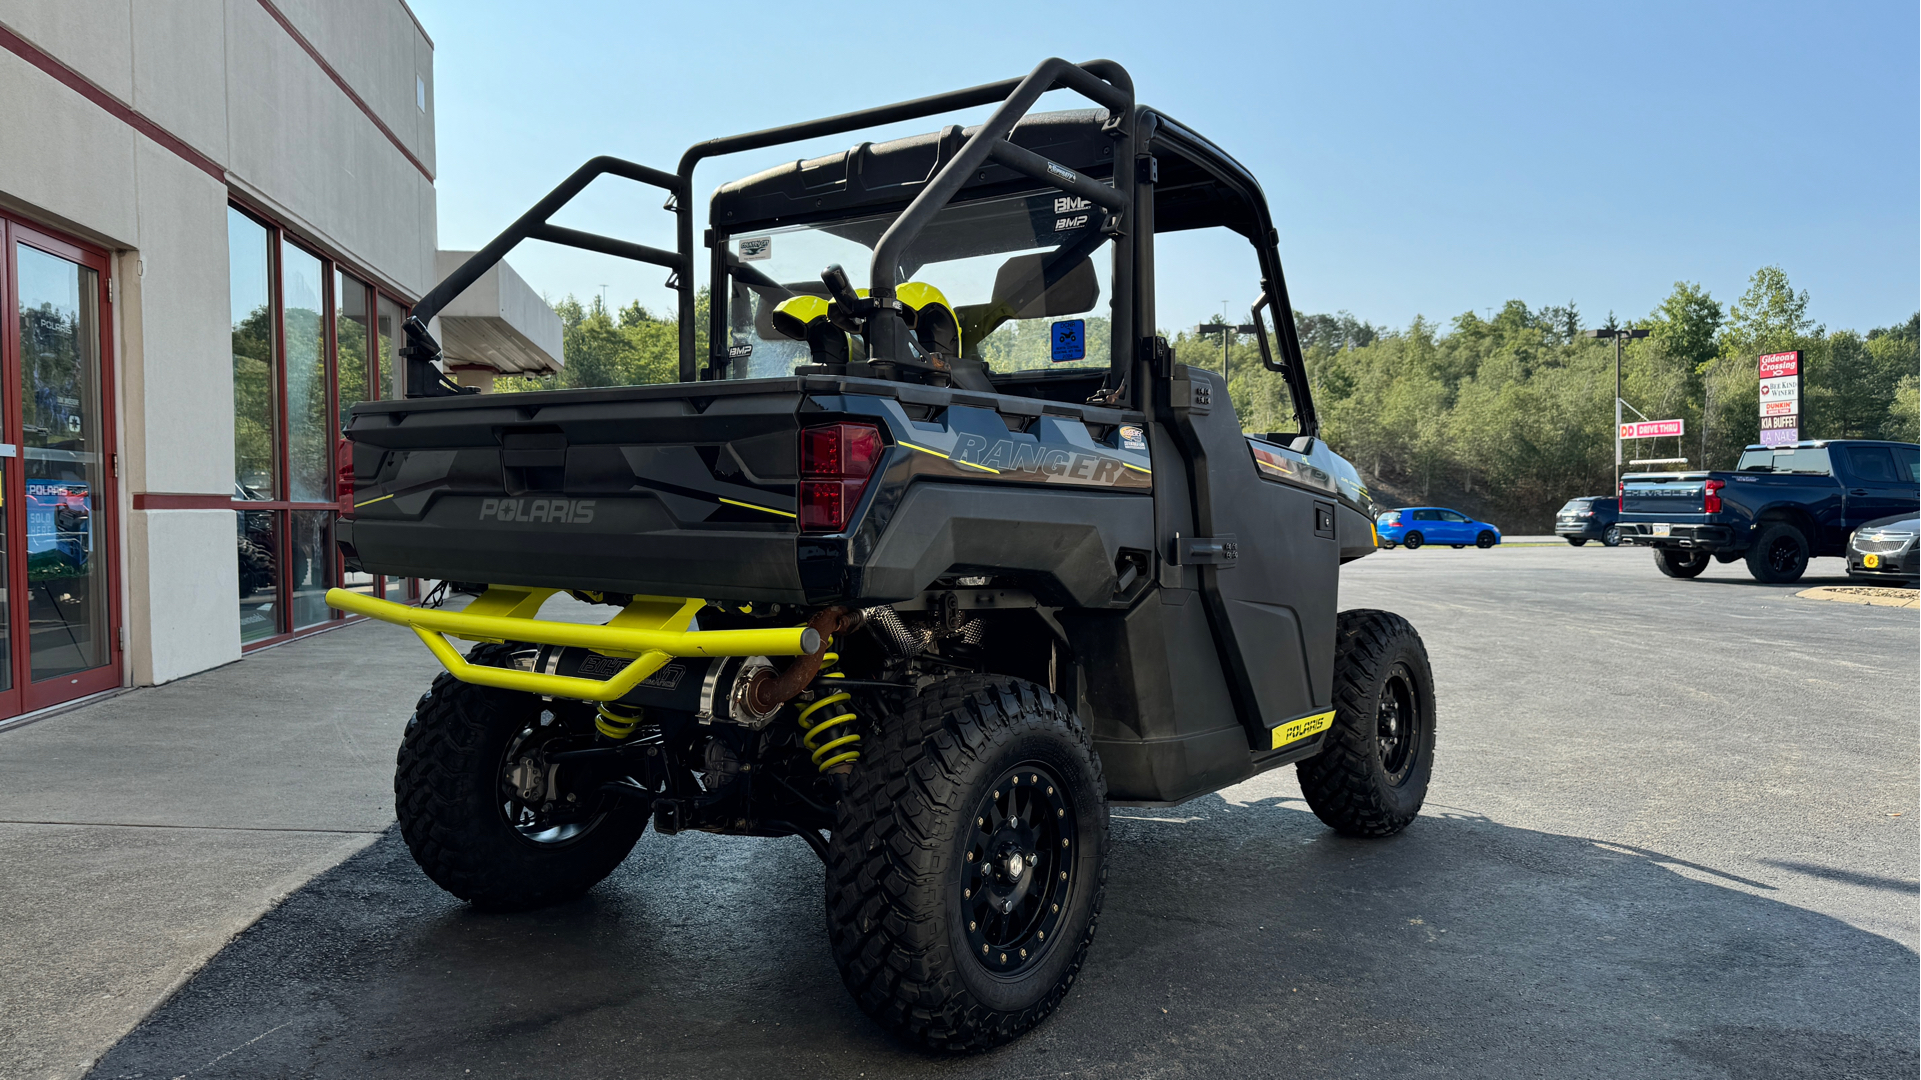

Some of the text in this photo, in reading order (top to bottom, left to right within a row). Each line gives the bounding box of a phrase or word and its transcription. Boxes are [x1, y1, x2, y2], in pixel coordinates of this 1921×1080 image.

[1055, 215, 1088, 229] BMP
[41, 319, 72, 335] POLARIS
[730, 345, 752, 356] BMP
[1762, 352, 1795, 364] Gideon's
[1761, 361, 1796, 372] Crossing
[1781, 381, 1797, 389] KIND
[1771, 389, 1796, 397] WINERY
[1761, 415, 1797, 430] KIA BUFFET
[1639, 425, 1659, 435] DRIVE
[1659, 423, 1679, 433] THRU
[1774, 429, 1798, 442] NAILS
[948, 432, 1128, 485] RANGER
[29, 484, 68, 496] POLARIS
[1625, 489, 1698, 497] CHEVROLET
[479, 499, 597, 524] POLARIS
[30, 513, 51, 524] SOLD
[31, 525, 52, 536] HERE
[1286, 716, 1324, 741] POLARIS
